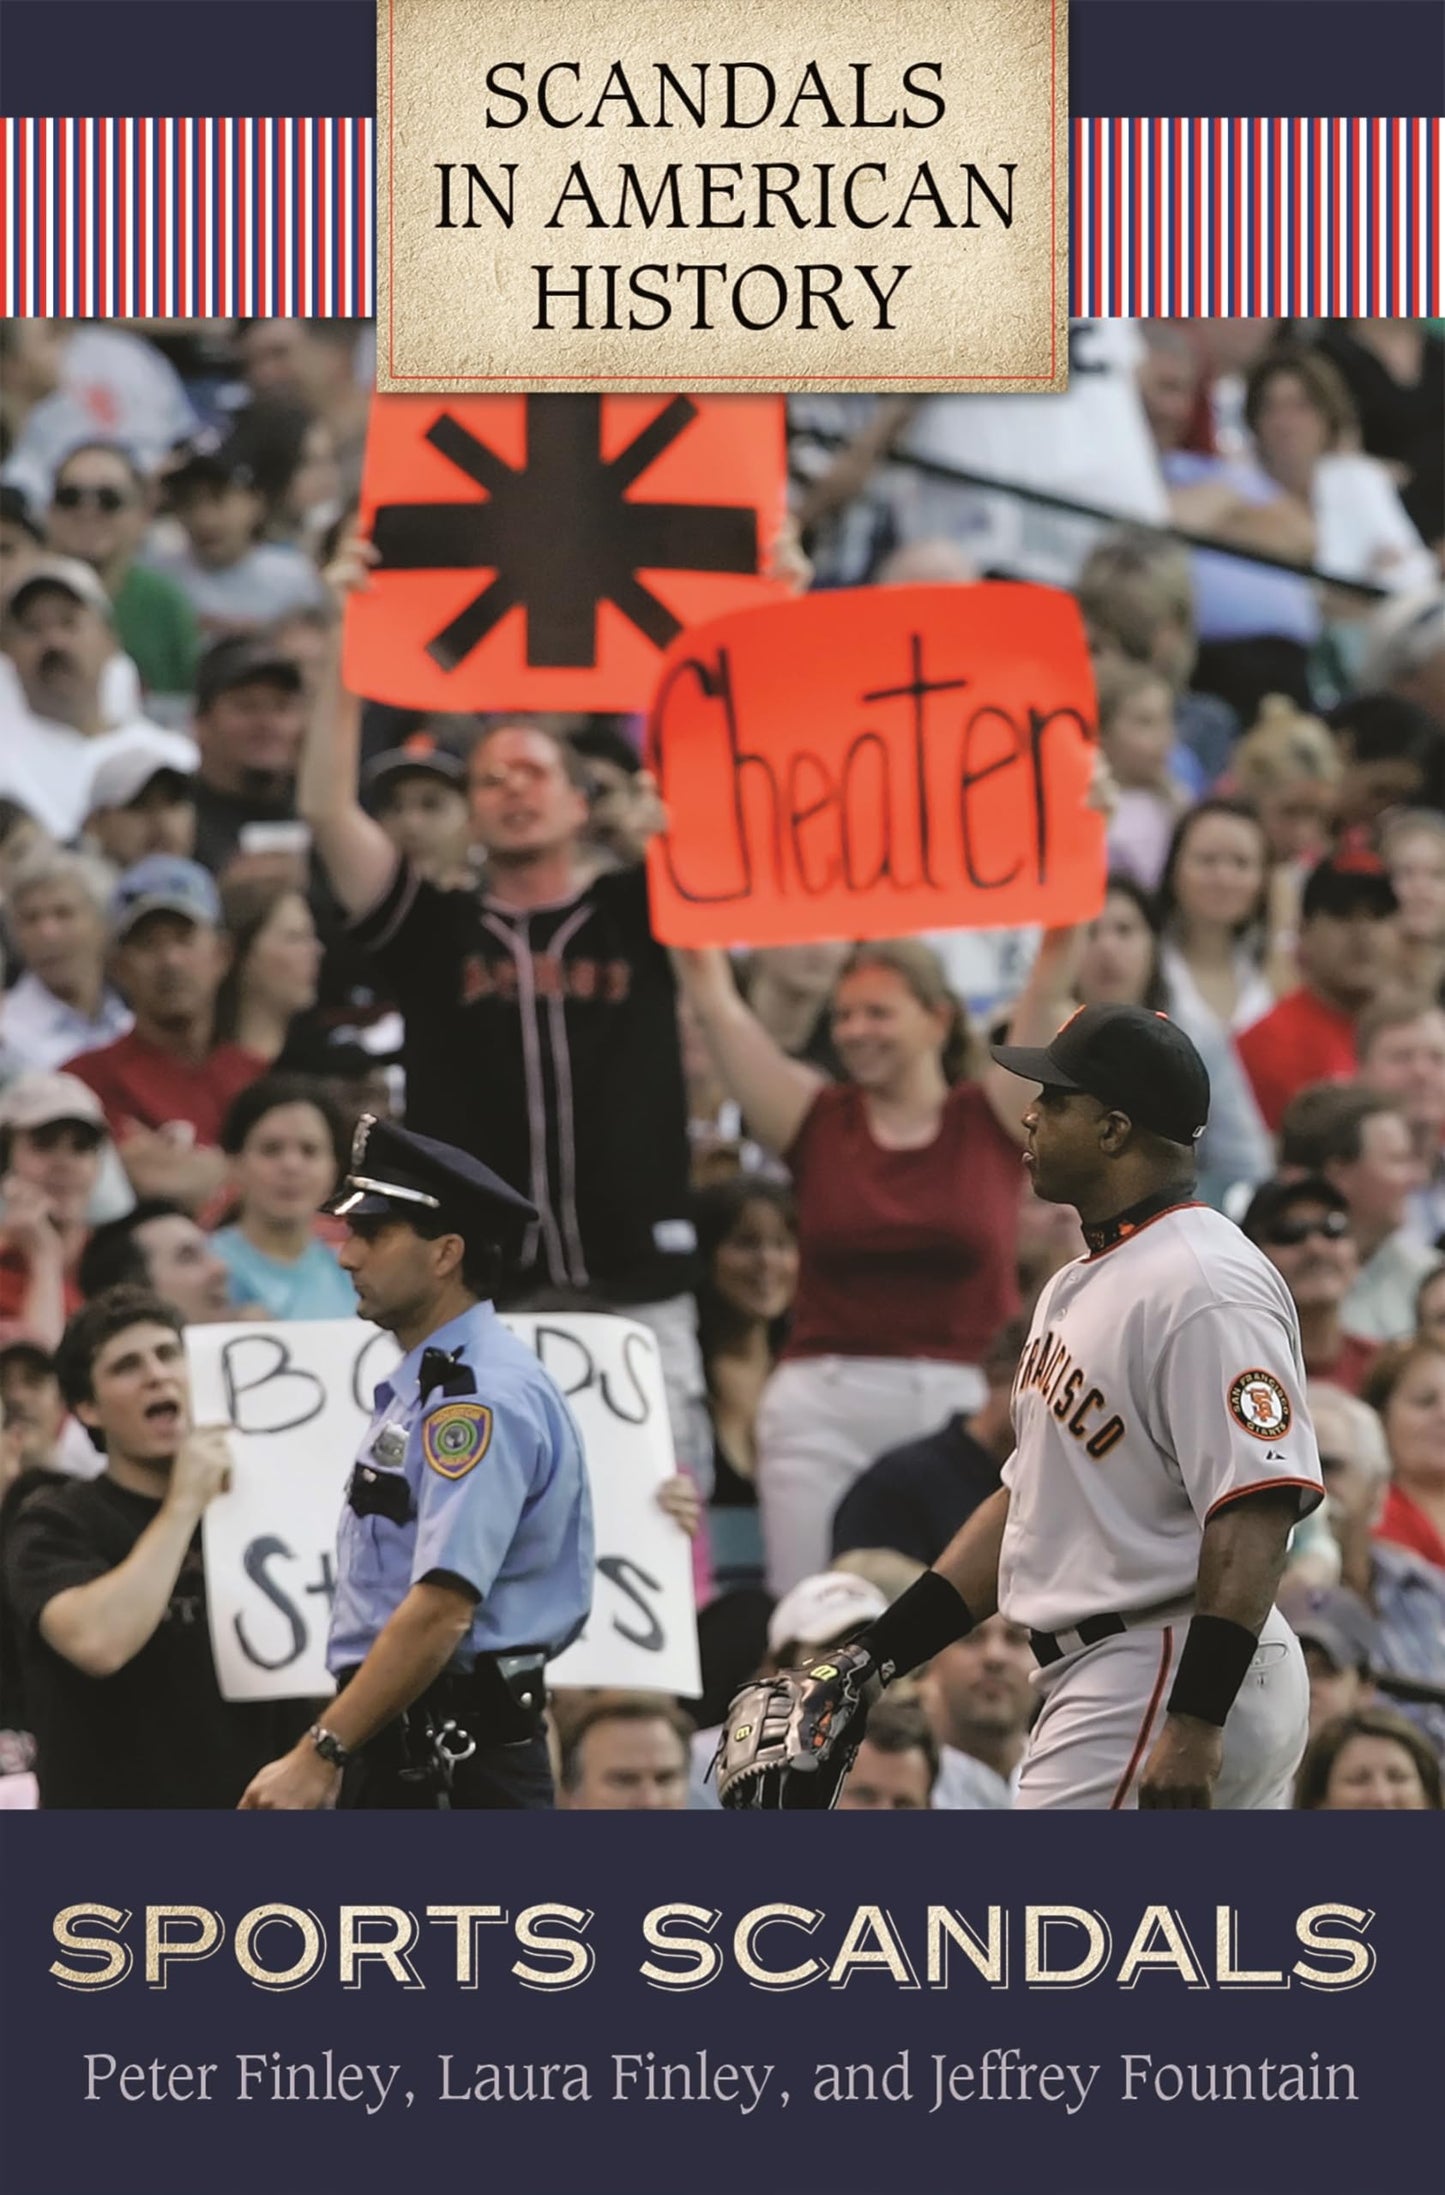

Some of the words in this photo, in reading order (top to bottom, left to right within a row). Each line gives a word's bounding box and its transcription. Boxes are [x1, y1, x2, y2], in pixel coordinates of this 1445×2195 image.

[647, 632, 1094, 904] Cheater
[220, 1324, 657, 1434] BDS
[1245, 1420, 1287, 1437] GIANTS
